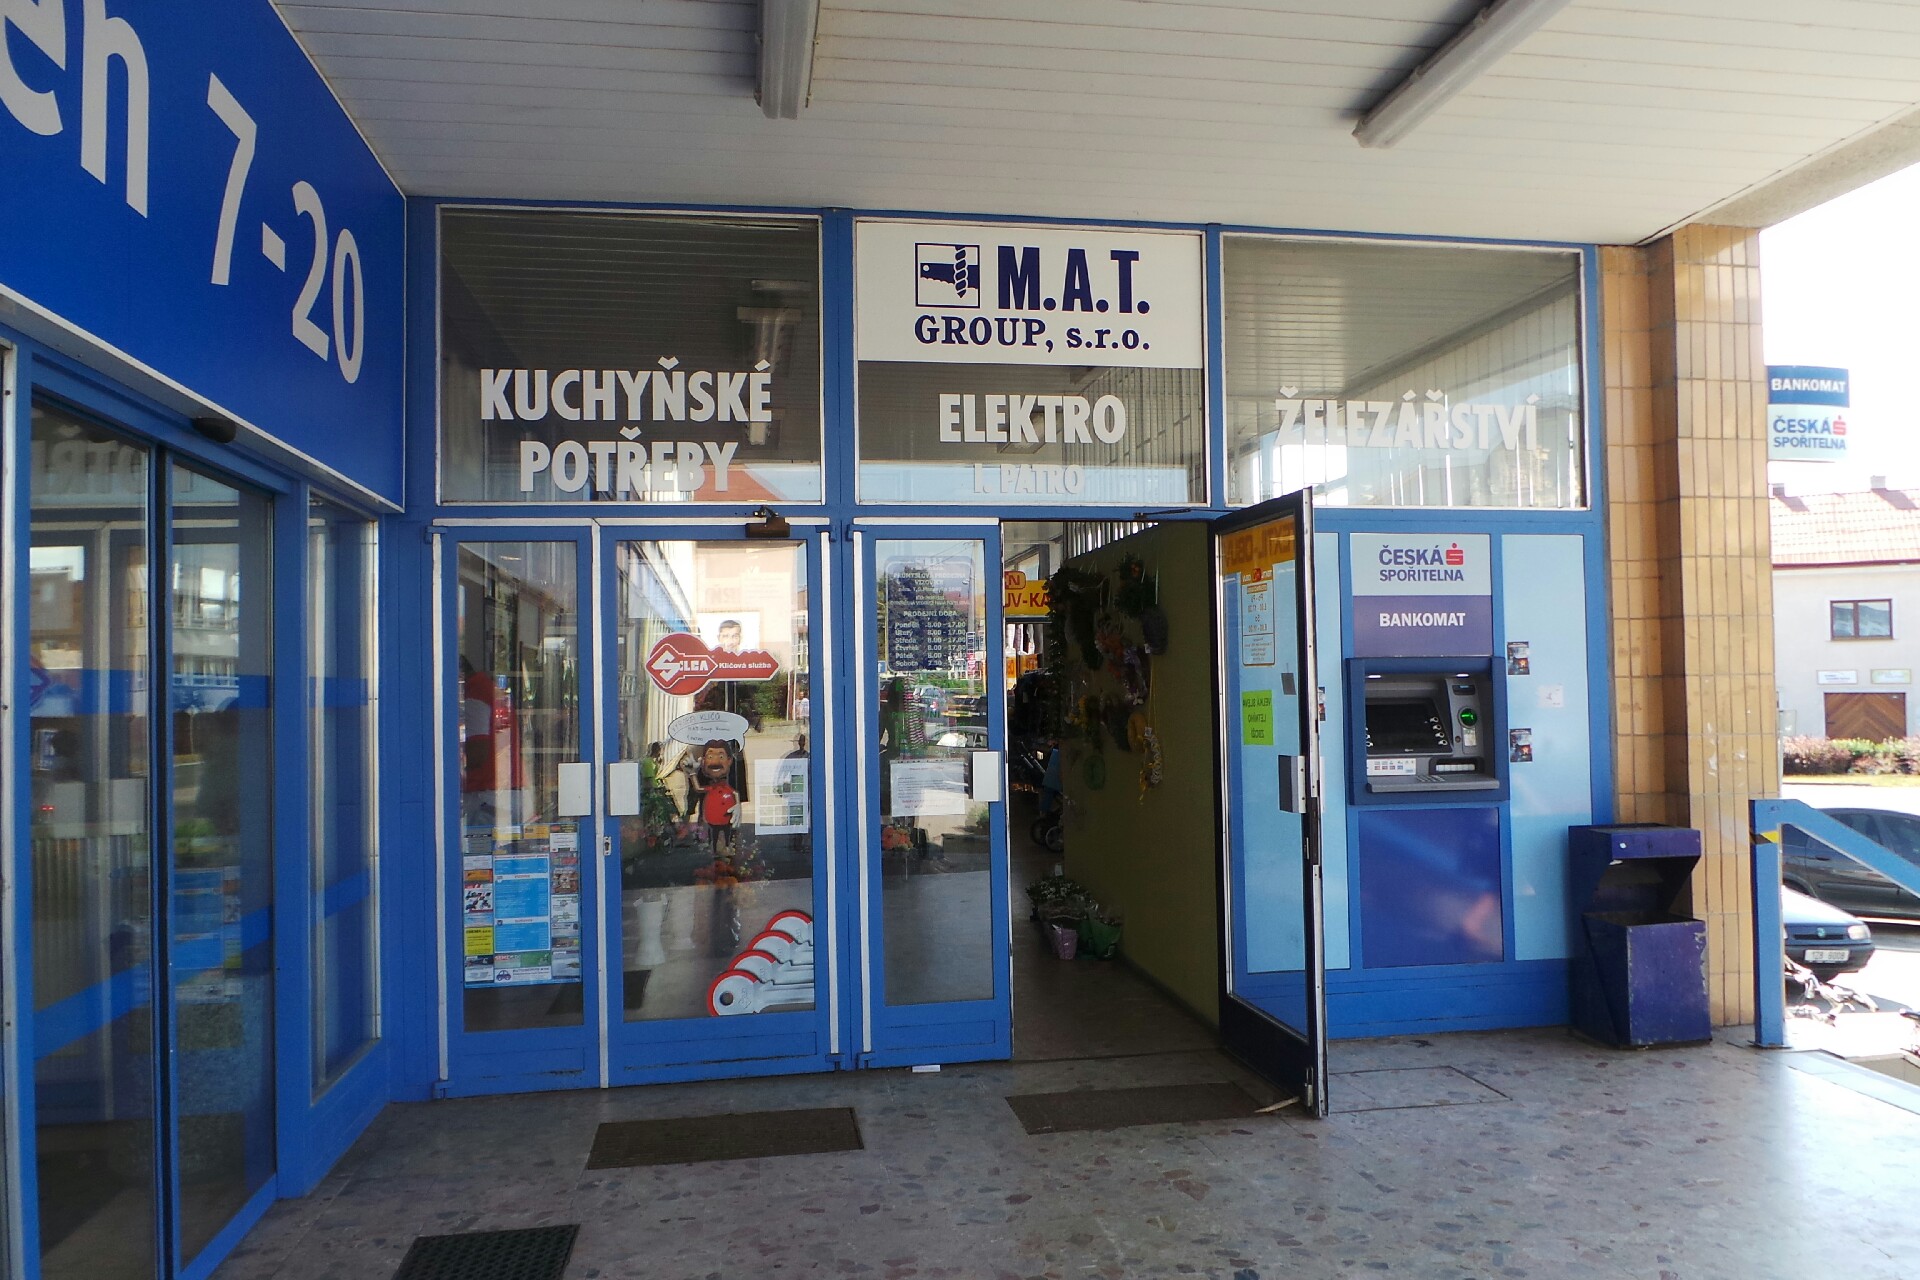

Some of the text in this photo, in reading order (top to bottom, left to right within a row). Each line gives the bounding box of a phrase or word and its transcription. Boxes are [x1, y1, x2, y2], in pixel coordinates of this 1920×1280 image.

[998, 246, 1150, 314] M.A.T.
[915, 315, 1149, 353] GROUP, s.r.o.
[481, 356, 772, 422] KUCHYŇSKÉ
[1771, 378, 1846, 393] BANKOMAT
[939, 393, 1126, 444] ELEKTRO
[1275, 385, 1540, 451] ŽELEZÁŘSTVÍ
[1773, 416, 1832, 434] ČESKÁ
[1773, 436, 1846, 450] SPOŘITELNA
[520, 426, 739, 492] POTŘEBY
[1000, 464, 1084, 494] PATRO
[1379, 544, 1443, 566] ČESKÁ
[1380, 567, 1464, 582] SPOŘITELNA
[1380, 612, 1465, 628] BANKOMAT
